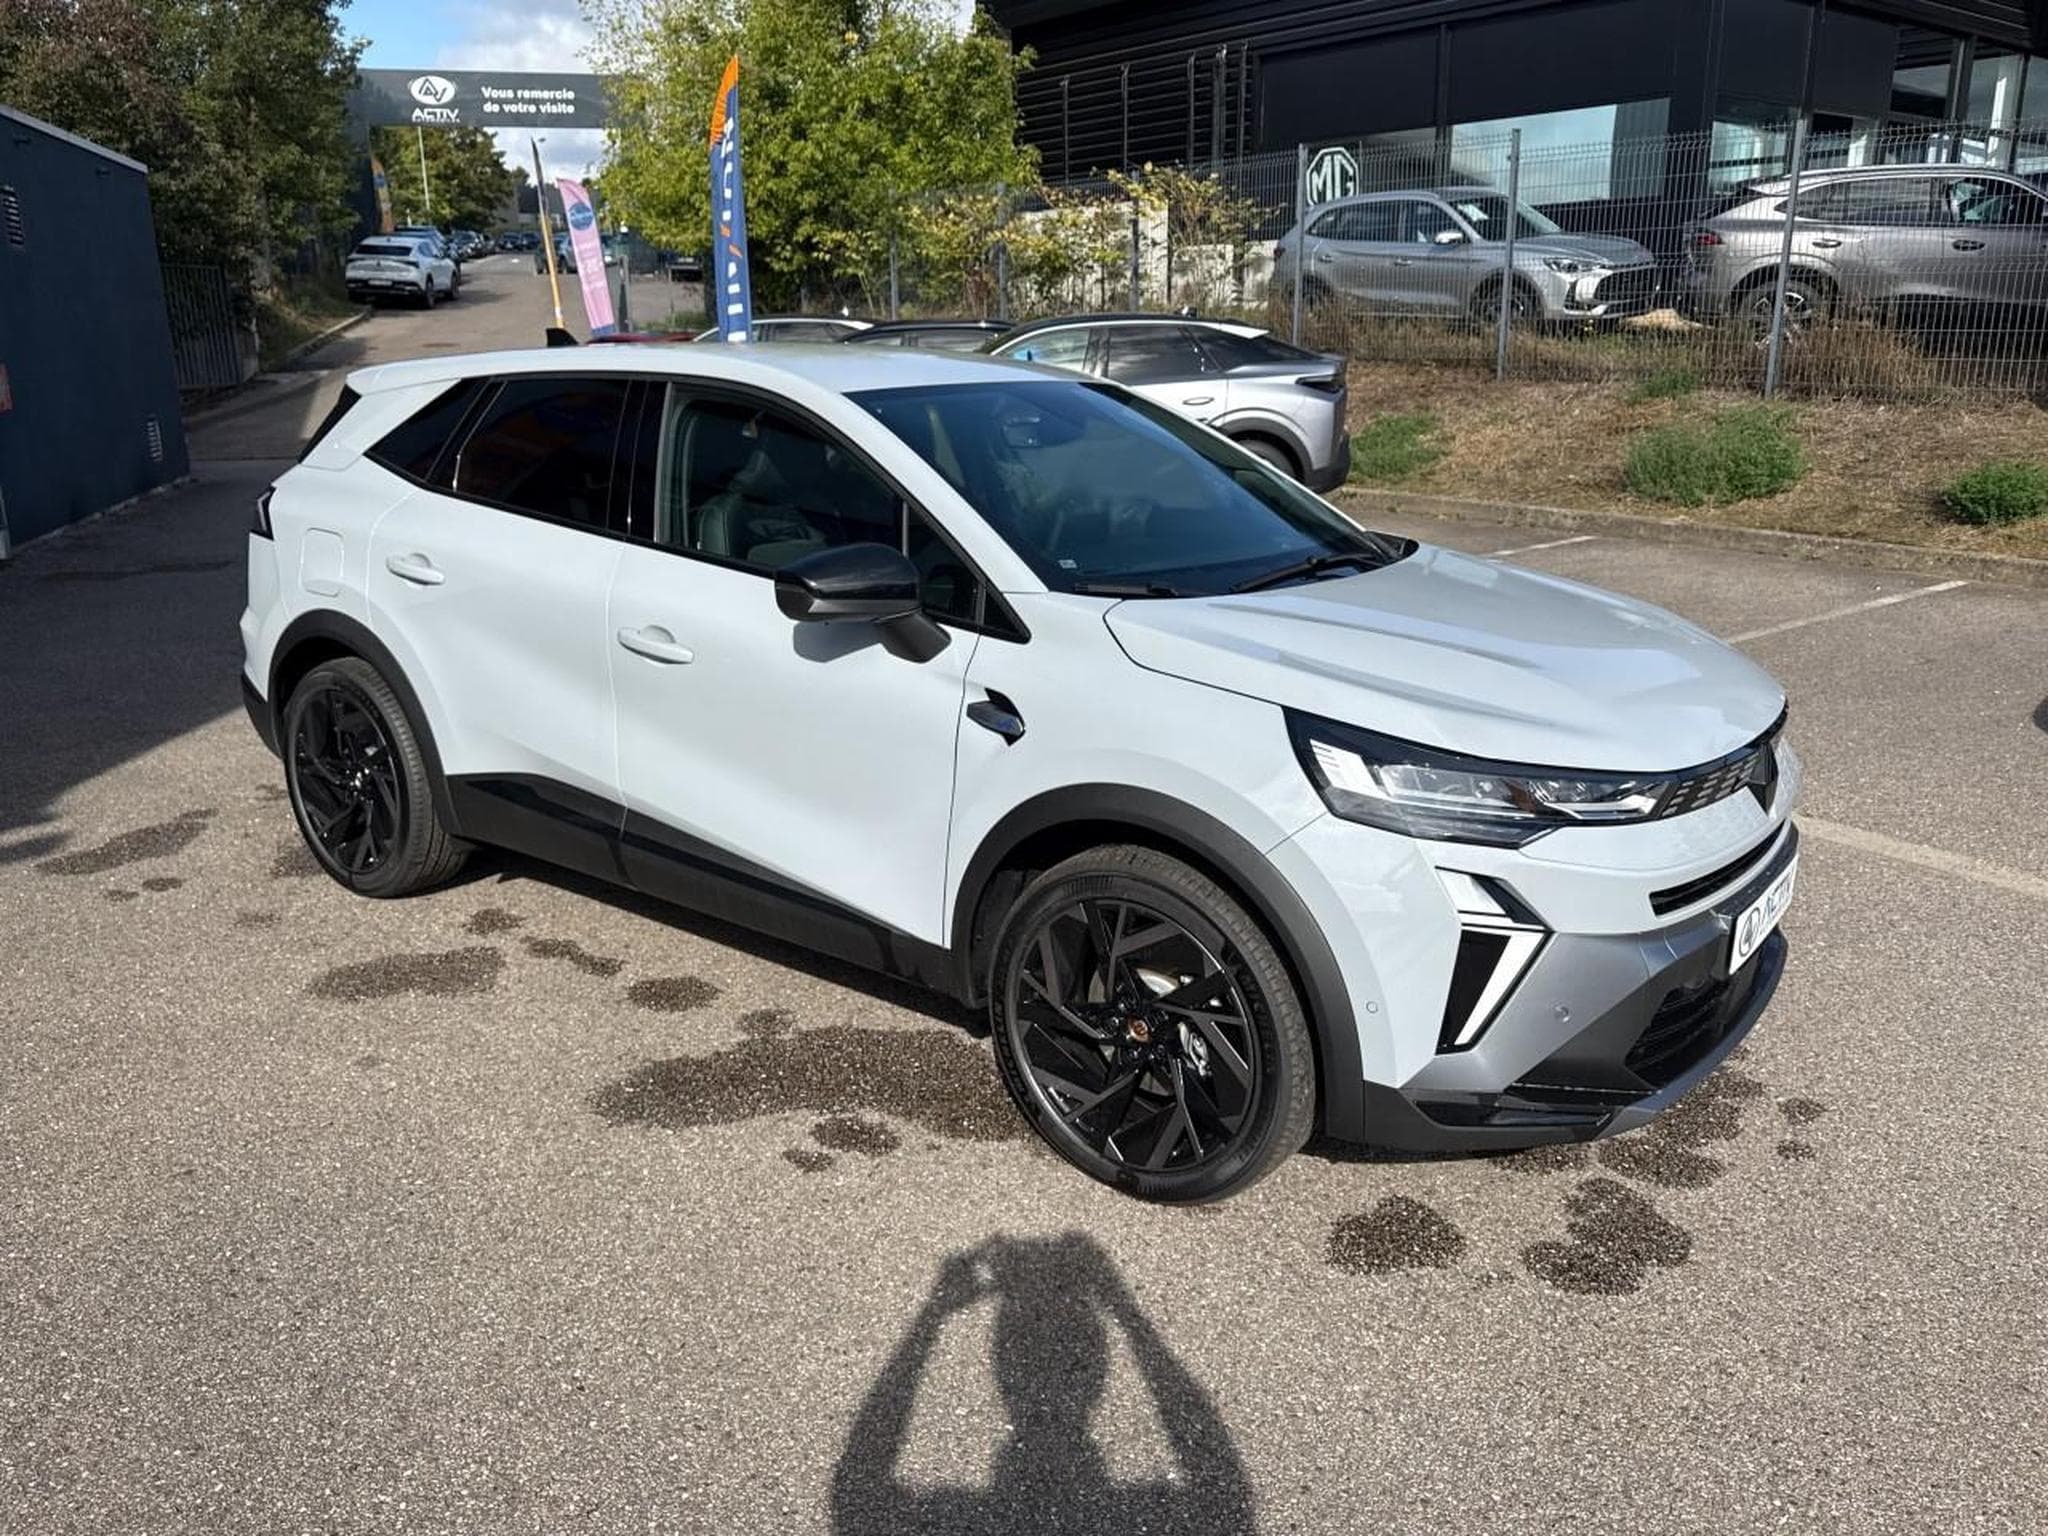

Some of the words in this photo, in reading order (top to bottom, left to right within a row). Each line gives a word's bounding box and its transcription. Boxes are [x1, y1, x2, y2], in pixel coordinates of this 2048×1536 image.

[481, 86, 515, 99] Vous
[516, 88, 576, 100] remercie
[412, 107, 460, 121] ACTIV
[483, 101, 500, 113] de
[502, 102, 537, 113] votre
[538, 102, 576, 114] visite
[1311, 153, 1355, 204] MG
